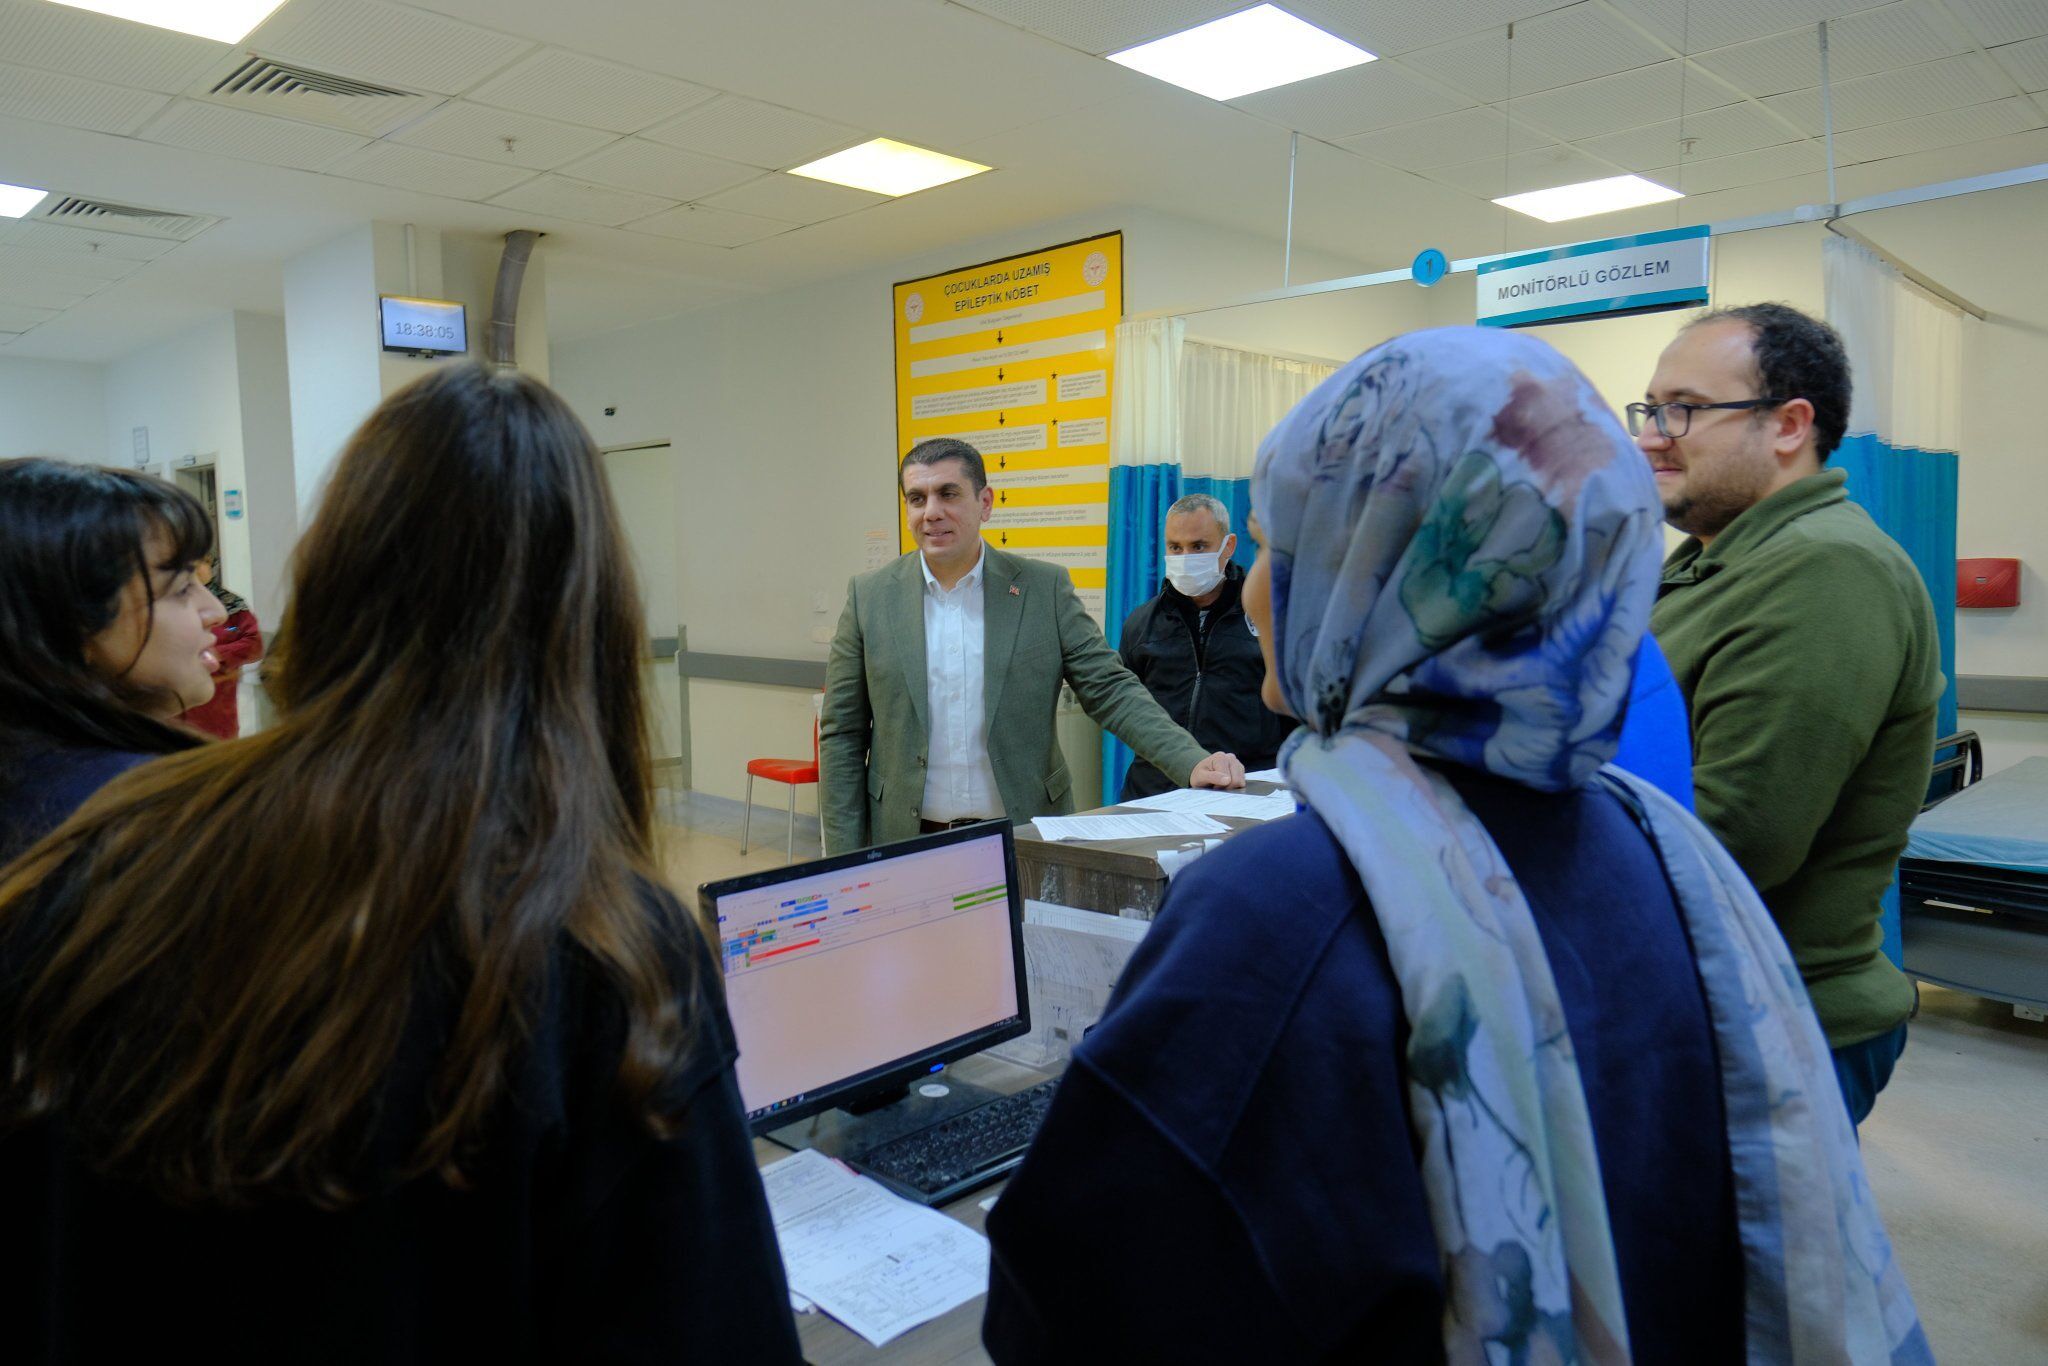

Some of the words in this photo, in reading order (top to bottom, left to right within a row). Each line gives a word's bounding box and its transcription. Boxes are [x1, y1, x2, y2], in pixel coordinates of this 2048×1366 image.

[944, 272, 1009, 297] ÇOCUKLARDA
[1013, 262, 1051, 281] UZAMIŞ
[1425, 258, 1433, 275] 1
[1498, 272, 1589, 300] MONİTÖRLÜ
[1595, 260, 1669, 284] GÖZLEM
[955, 291, 1003, 312] EPİLEPTİK
[1005, 284, 1039, 302] NÖBET
[395, 321, 455, 340] 18:38:05
